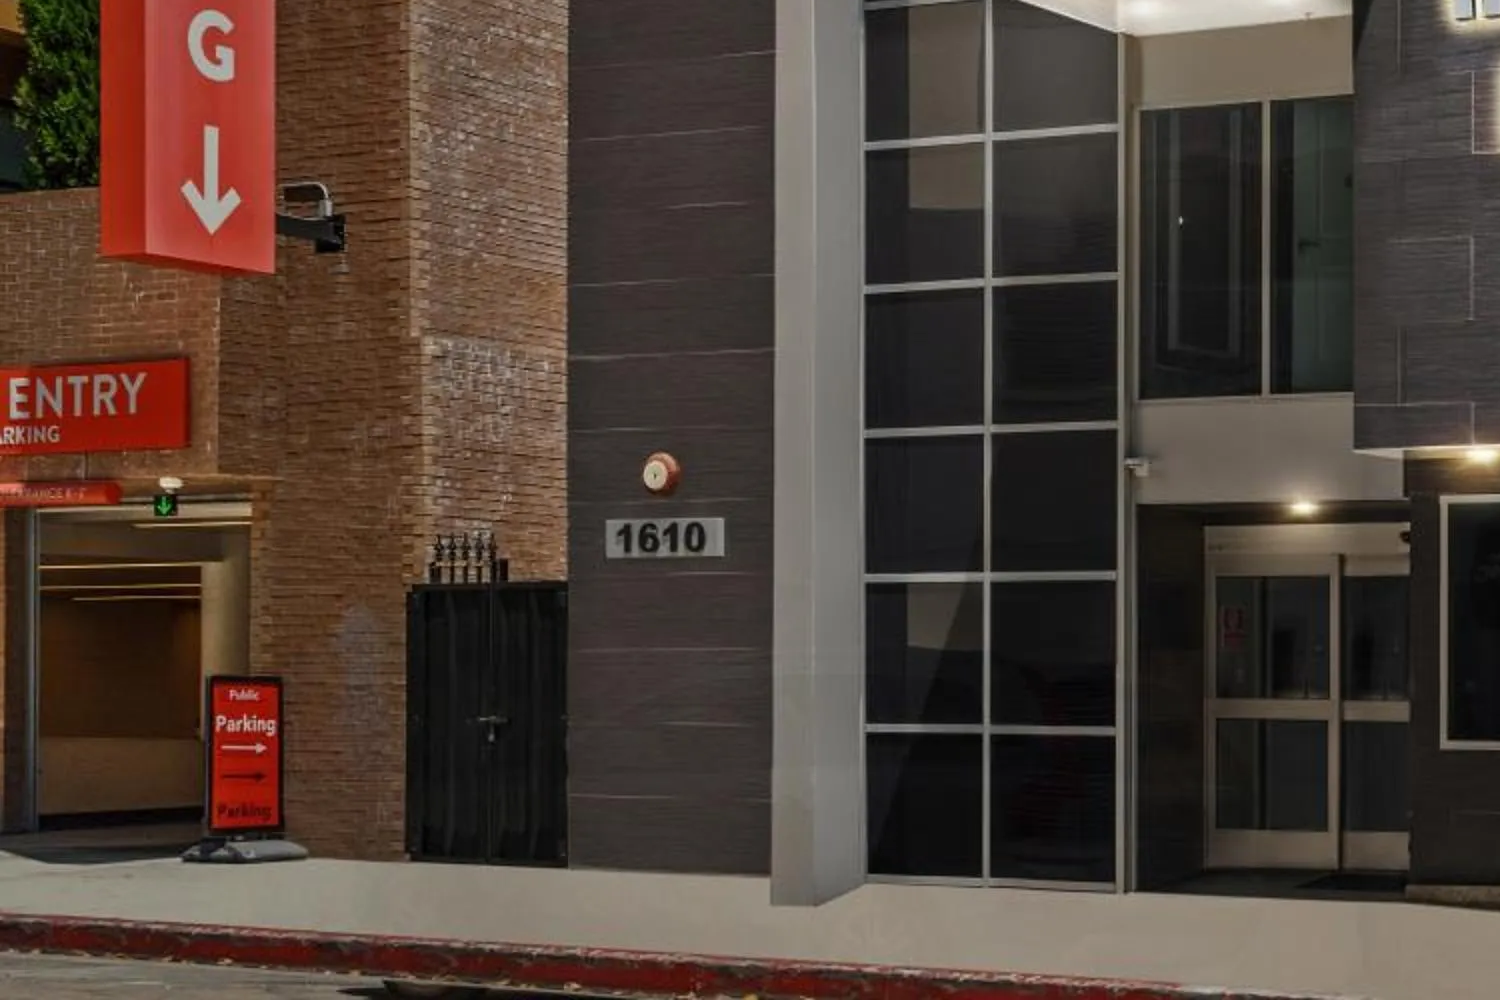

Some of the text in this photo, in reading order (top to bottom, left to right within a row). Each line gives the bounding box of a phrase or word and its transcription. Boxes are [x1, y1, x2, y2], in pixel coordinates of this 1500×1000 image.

[8, 371, 148, 420] ENTRY
[616, 522, 707, 553] 1610
[228, 689, 260, 702] Public
[215, 713, 277, 737] Parking
[216, 805, 273, 822] Parking
